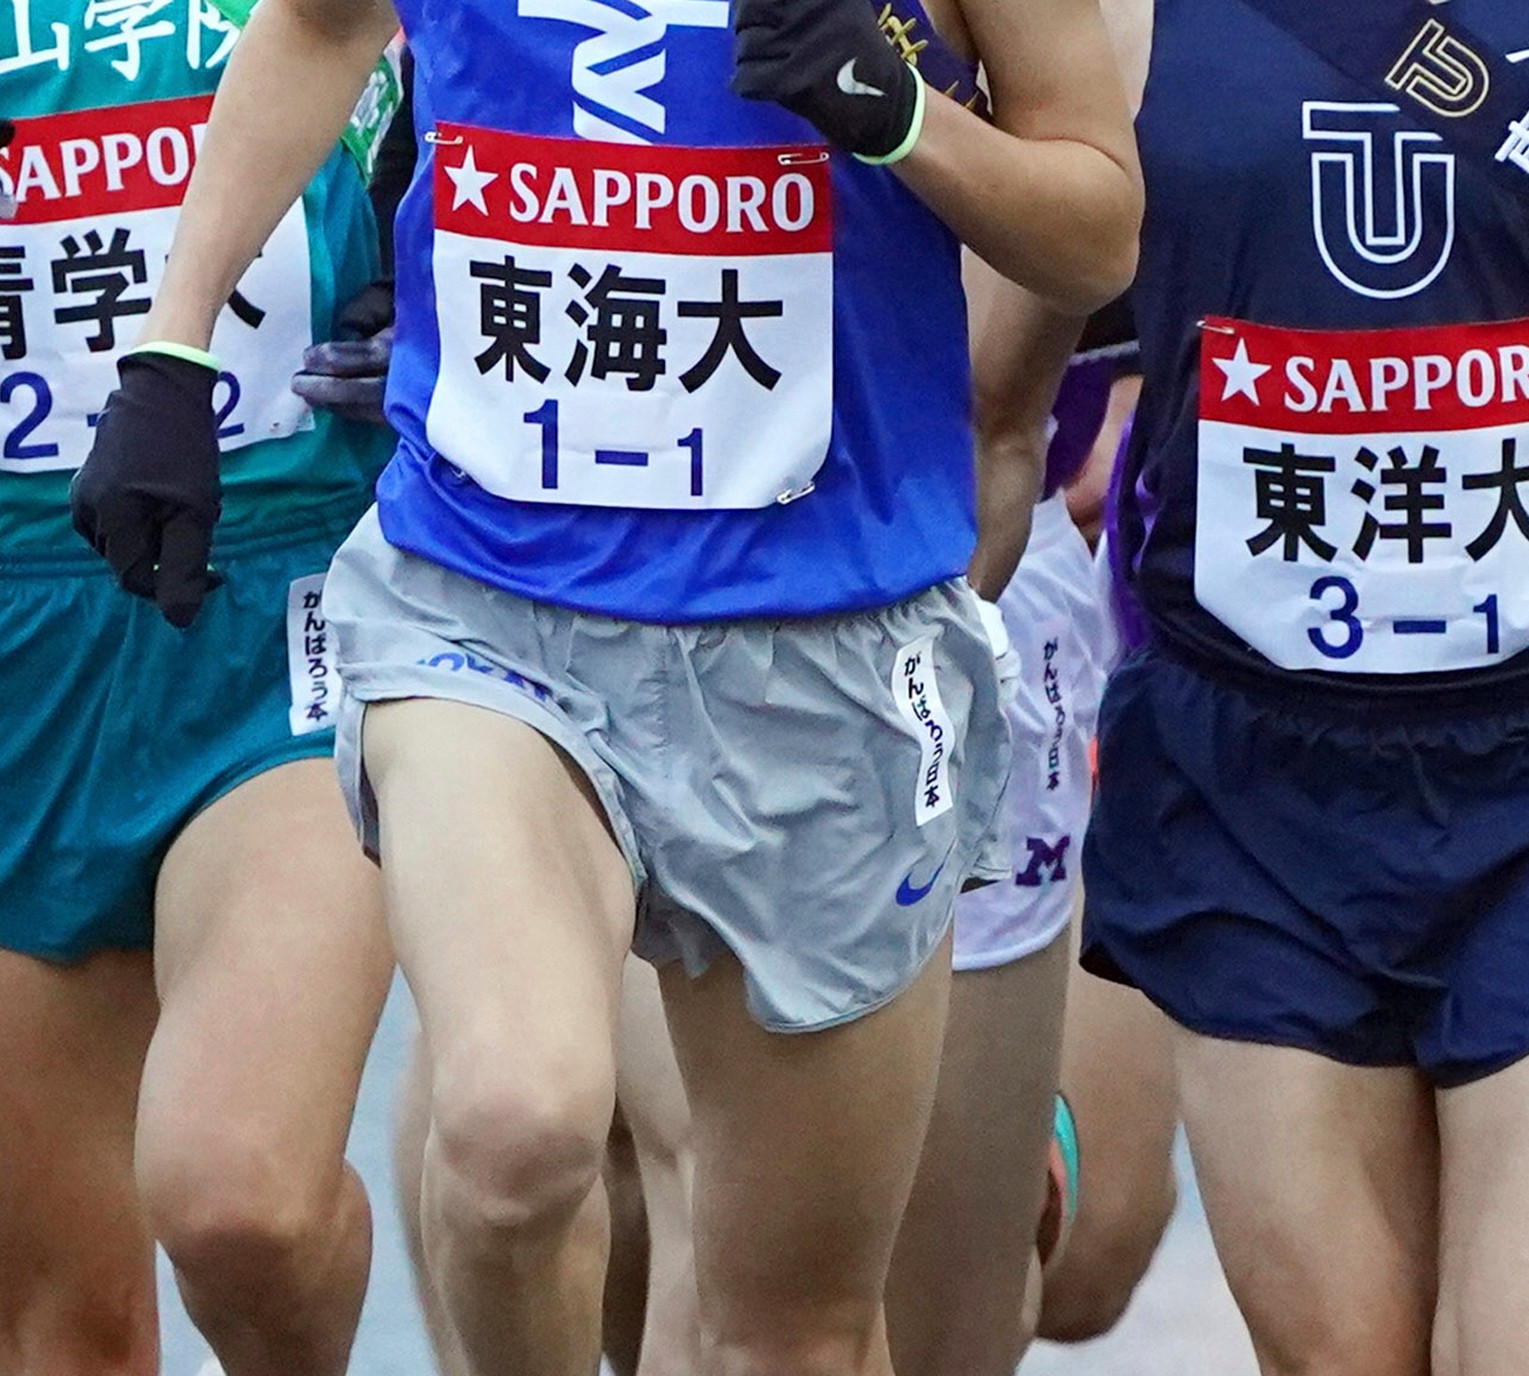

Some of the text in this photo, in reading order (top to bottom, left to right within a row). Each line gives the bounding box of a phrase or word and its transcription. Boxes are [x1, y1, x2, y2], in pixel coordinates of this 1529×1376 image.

[509, 161, 815, 234] SAPPORO
[469, 255, 783, 393] 東海大
[523, 399, 703, 496] 1-1
[1307, 576, 1501, 659] 3-1
[904, 651, 944, 808] がんばろう日本
[1015, 834, 1071, 887] M
